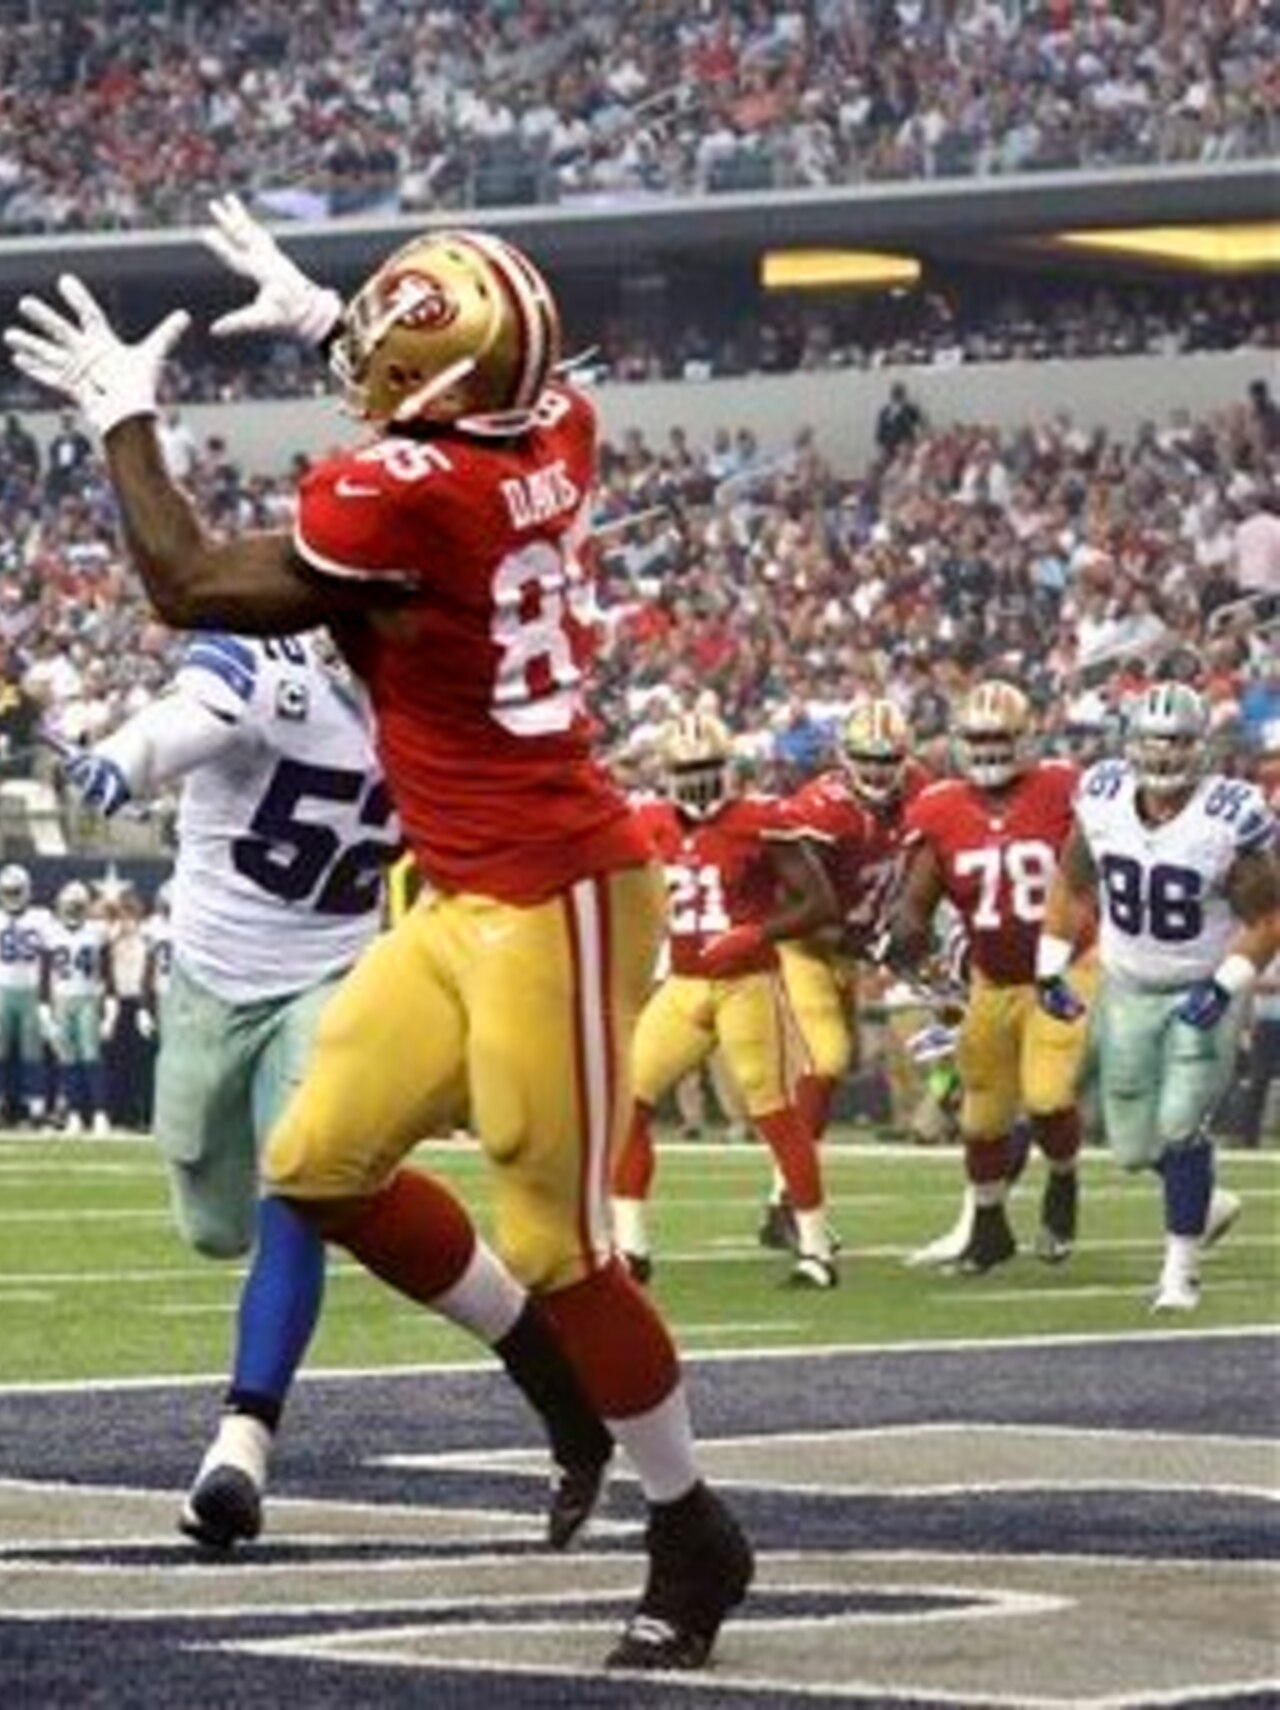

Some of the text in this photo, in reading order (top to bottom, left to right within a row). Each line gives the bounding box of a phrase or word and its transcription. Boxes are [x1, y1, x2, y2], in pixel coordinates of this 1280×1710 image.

[501, 460, 578, 530] DAVIS
[663, 864, 730, 933] 21
[956, 840, 1056, 928] 78
